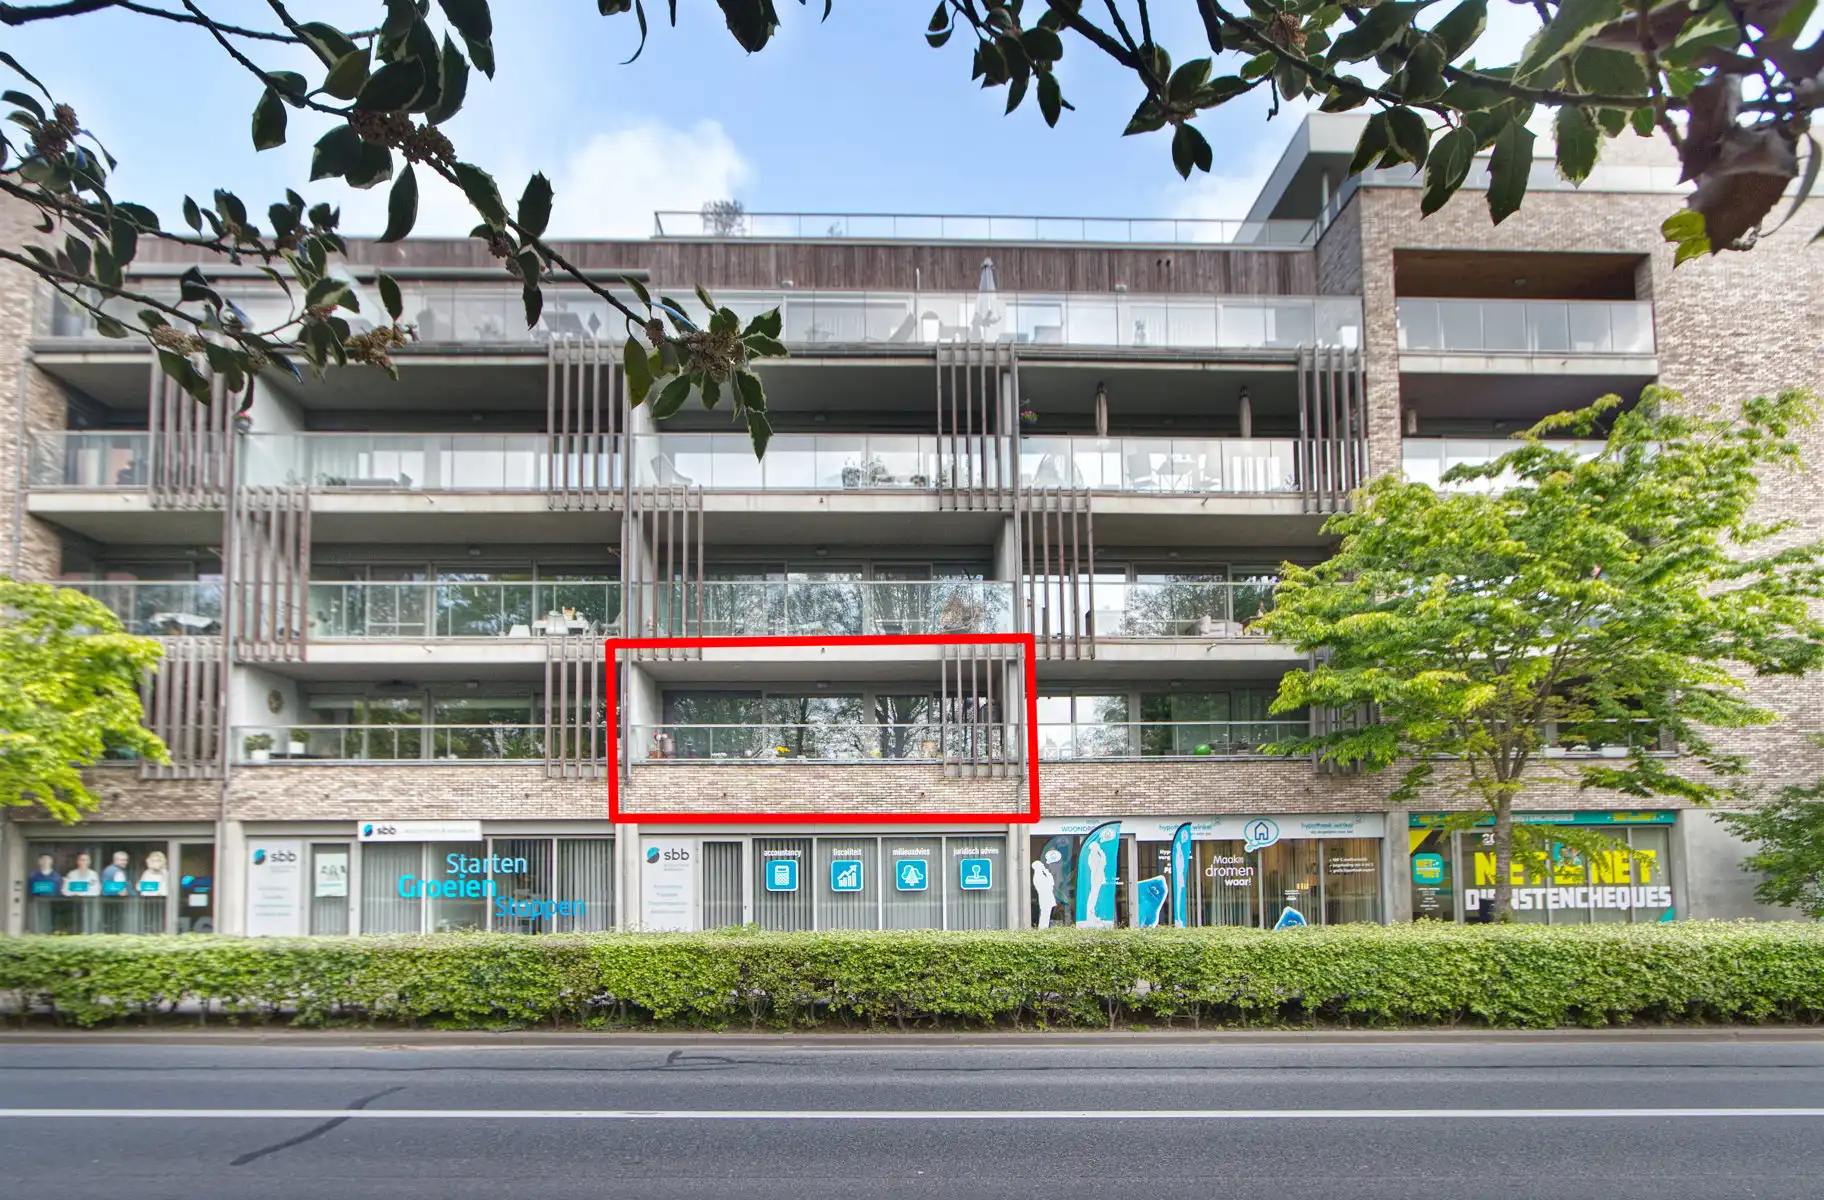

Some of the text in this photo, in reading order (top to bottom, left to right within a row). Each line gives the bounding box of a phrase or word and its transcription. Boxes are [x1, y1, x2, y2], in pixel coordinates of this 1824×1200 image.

[377, 825, 397, 835] sbb
[270, 850, 297, 862] sbb
[664, 848, 690, 861] sbb
[764, 849, 801, 857] accountancy
[832, 848, 862, 856] fiscaliteit
[892, 848, 930, 856] milieuadvies
[953, 847, 999, 857] juridisch advies
[446, 853, 527, 874] Starten
[1205, 864, 1254, 877] dromen
[398, 874, 497, 898] Groeien
[1224, 877, 1252, 886] waar!
[1464, 886, 1672, 911] DSTENCHEQUES
[494, 896, 585, 921] Stoppen
